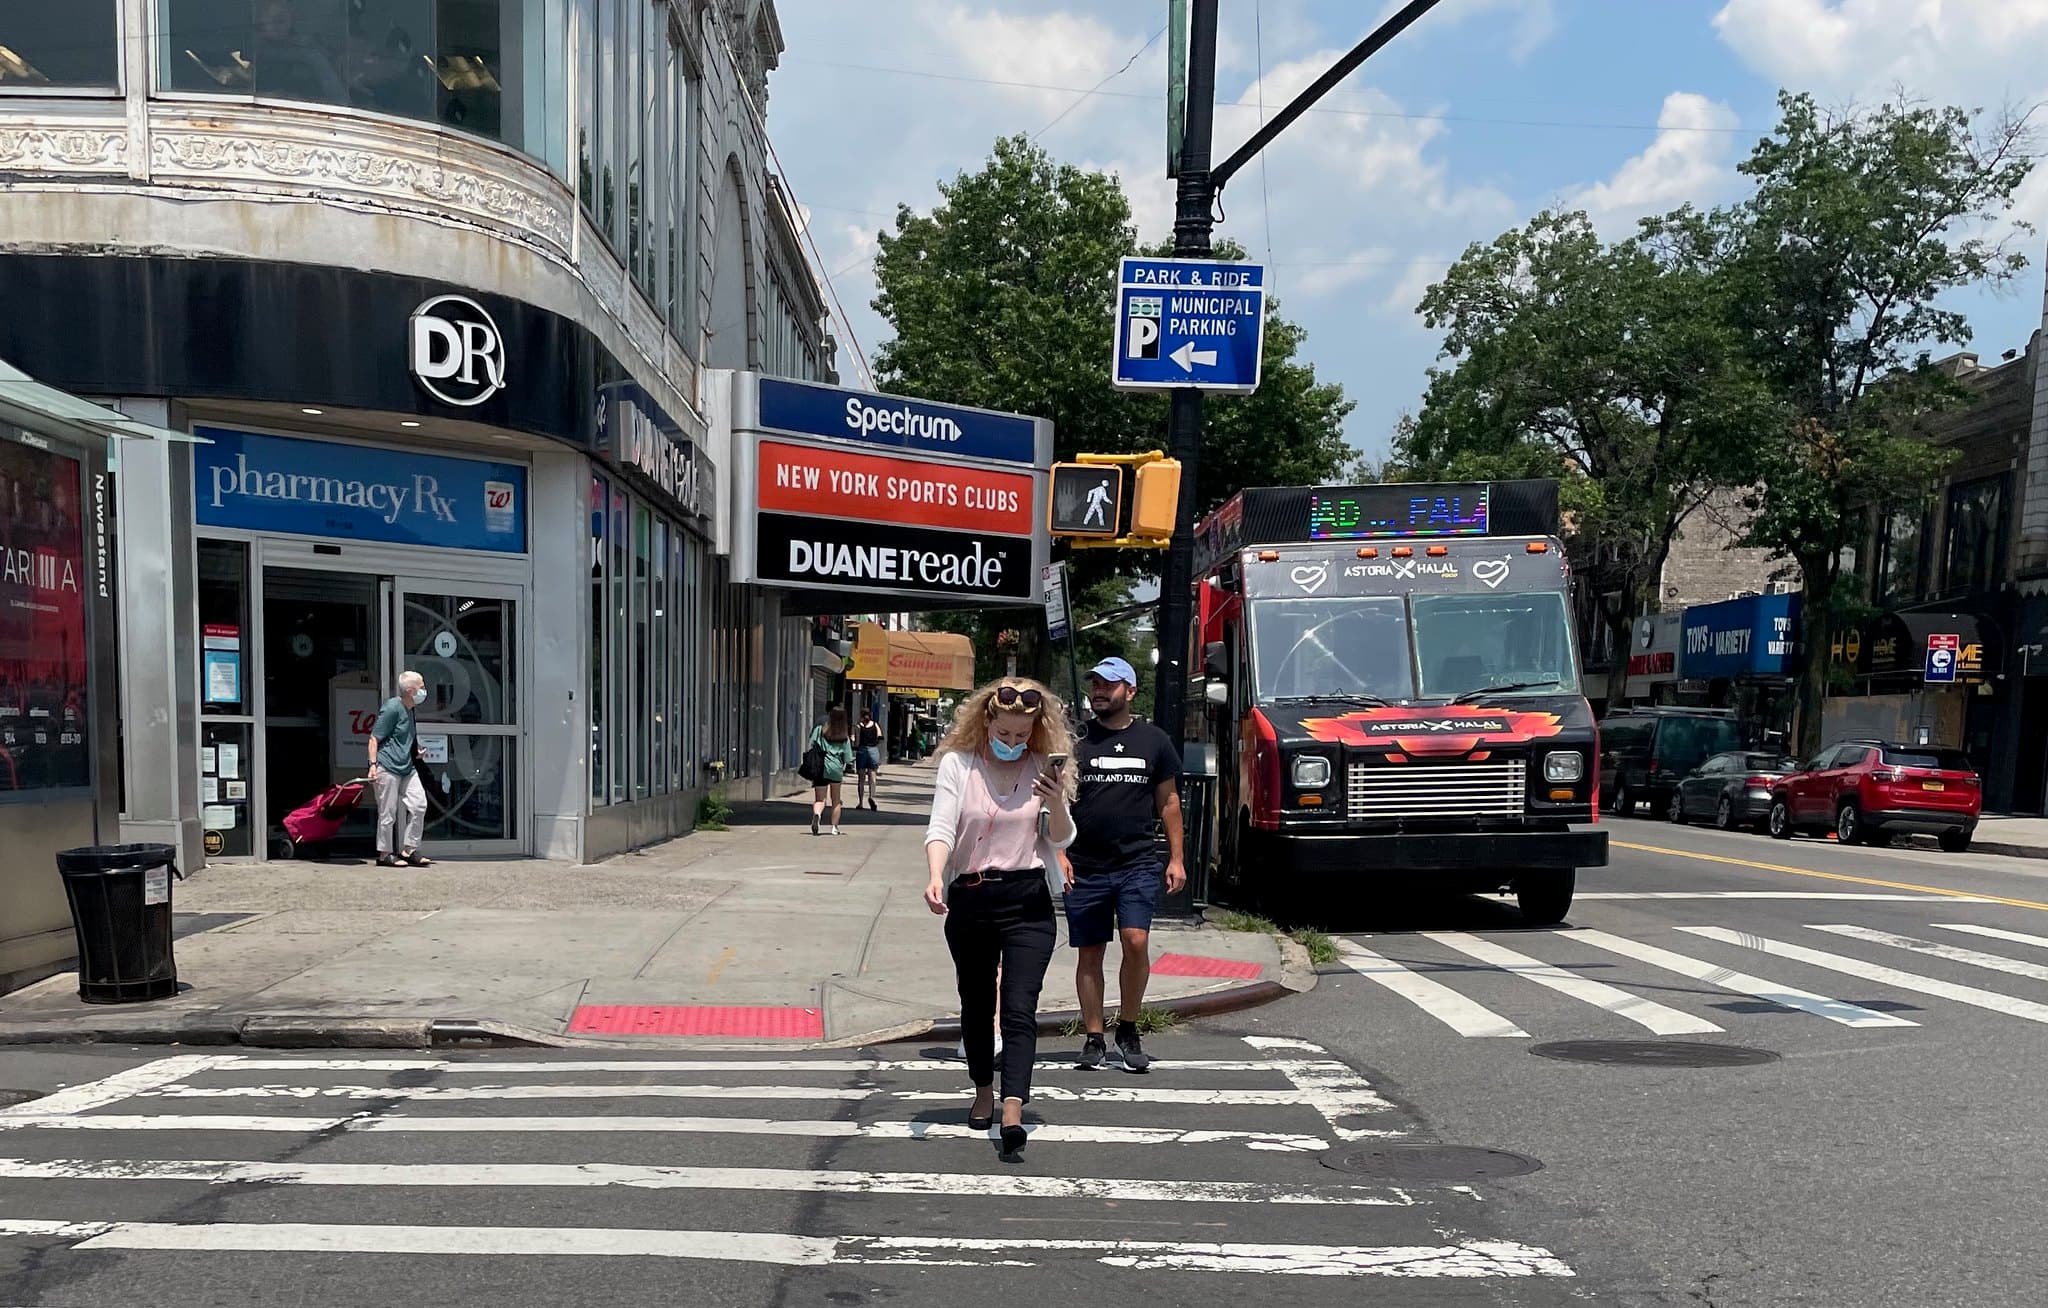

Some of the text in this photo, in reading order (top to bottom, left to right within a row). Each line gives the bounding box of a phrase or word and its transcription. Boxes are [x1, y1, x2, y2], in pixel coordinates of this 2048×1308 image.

[1134, 268, 1251, 287] PARK & RIDE
[1171, 297, 1254, 316] MUNICIPAL
[1169, 318, 1237, 336] PARKING
[1128, 318, 1159, 358] P
[410, 315, 506, 388] DR
[846, 398, 955, 442] Spectrum
[209, 452, 457, 524] pharmacy Rx
[776, 463, 1019, 514] NEW YORK SPORTS CLUBS
[1343, 562, 1459, 577] ASTORIA HALAL
[1774, 617, 1792, 632] TOYS
[1686, 624, 1709, 655] TOYS
[1715, 628, 1752, 655] VARIETY
[1371, 723, 1427, 732] ASTORIA
[1454, 720, 1502, 729] HALAL
[1083, 774, 1105, 783] COME
[1105, 773, 1123, 783] AND
[1123, 774, 1143, 784] TAKE
